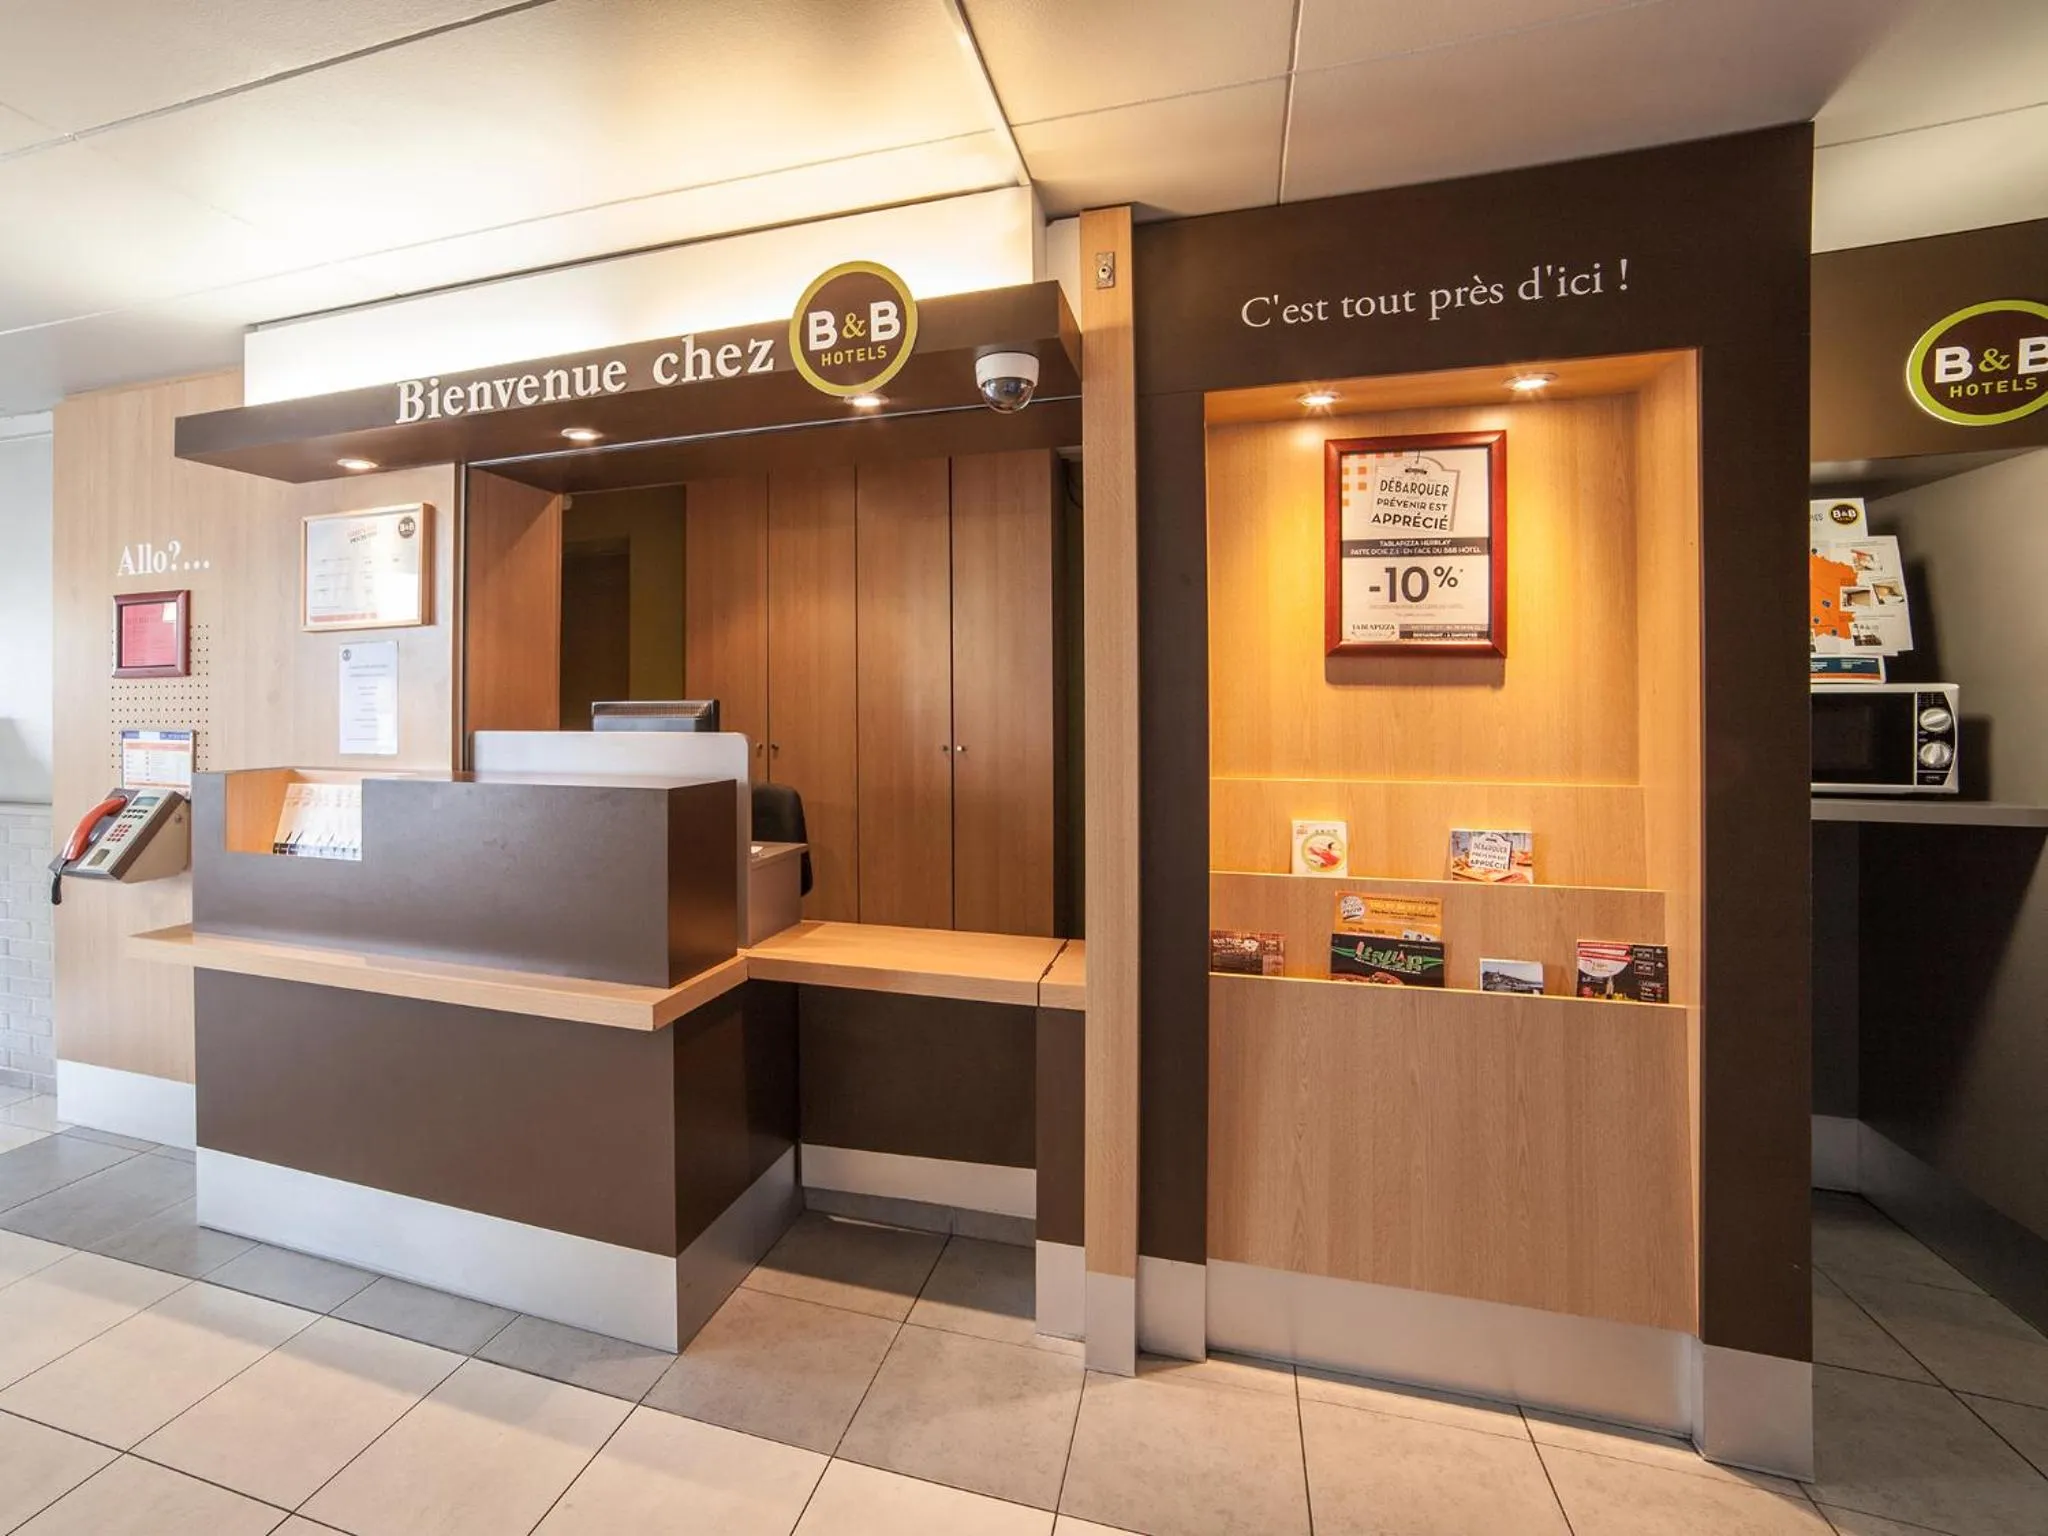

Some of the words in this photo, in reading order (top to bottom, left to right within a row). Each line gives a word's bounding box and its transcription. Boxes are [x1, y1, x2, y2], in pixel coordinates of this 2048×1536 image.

[1241, 294, 1329, 328] C'est
[1340, 289, 1416, 320] tout
[1429, 274, 1504, 321] près
[1517, 262, 1605, 301] d'ici
[821, 344, 888, 367] HOTELS
[396, 359, 628, 425] Bienvenue
[653, 335, 775, 386] chez
[1949, 376, 2038, 399] HOTELS
[1380, 477, 1450, 497] DÉBARQUER
[1376, 496, 1428, 511] PRÉVENIR
[1429, 502, 1448, 512] EST
[1371, 511, 1449, 531] APPRÉCIÉ
